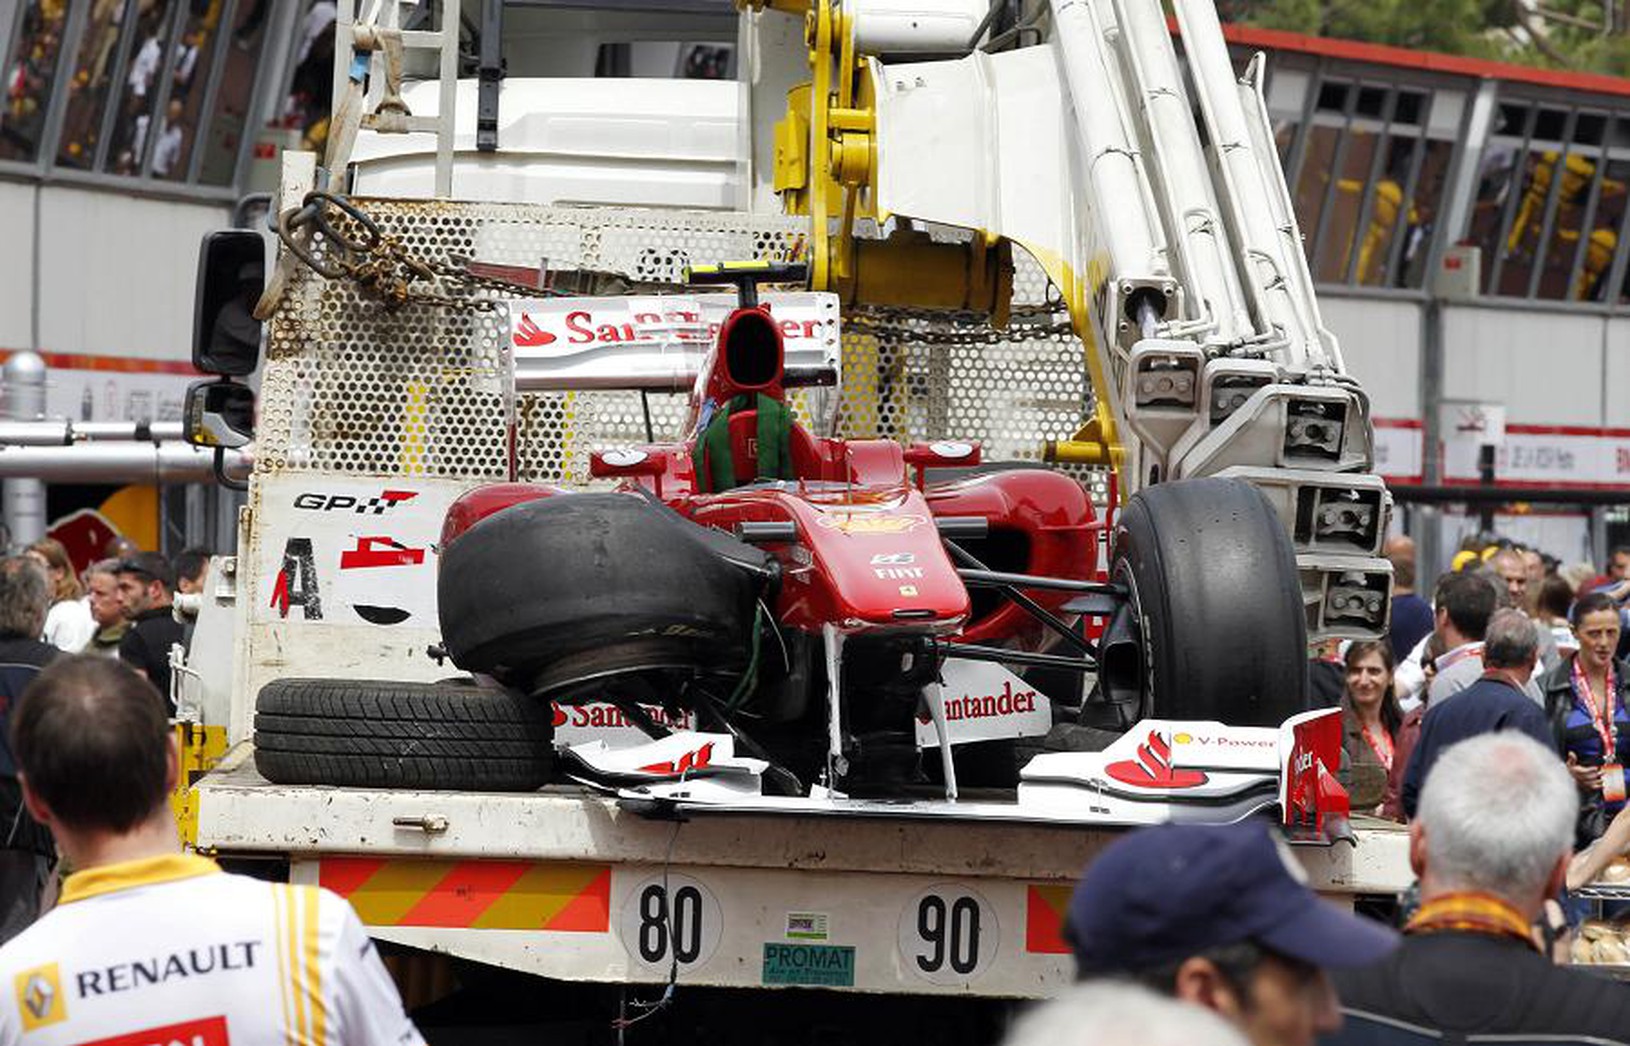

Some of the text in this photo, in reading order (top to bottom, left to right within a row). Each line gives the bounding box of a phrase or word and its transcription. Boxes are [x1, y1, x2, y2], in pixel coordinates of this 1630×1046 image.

[945, 681, 1037, 720] antander
[1198, 736, 1277, 748] V-Power
[638, 884, 703, 963] 80
[916, 894, 980, 974] 90
[75, 940, 262, 999] RENAULT
[766, 946, 854, 969] PROMAT
